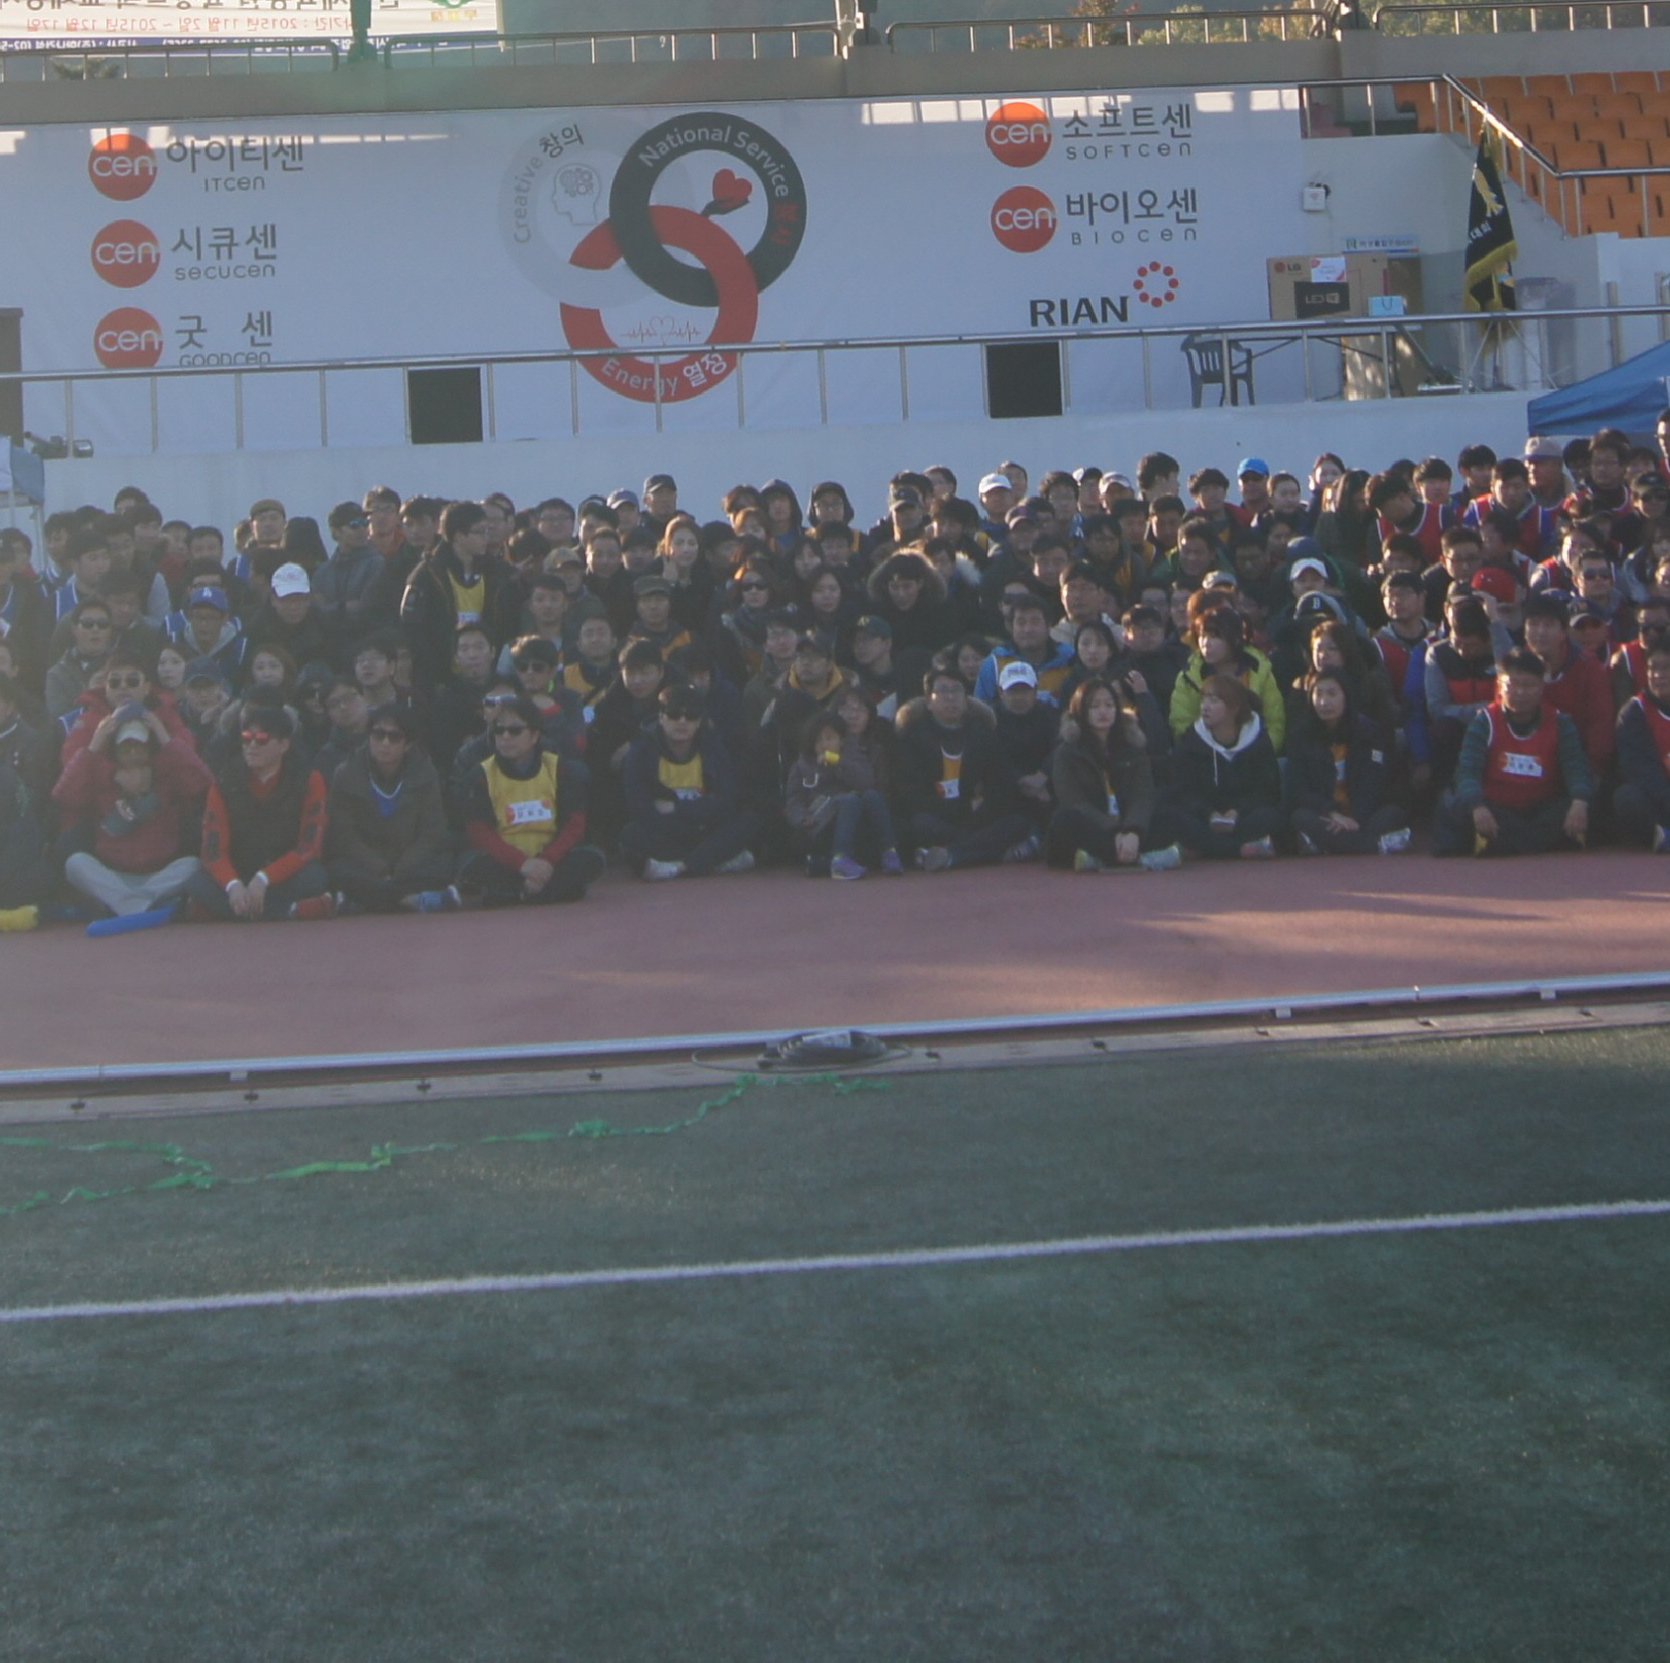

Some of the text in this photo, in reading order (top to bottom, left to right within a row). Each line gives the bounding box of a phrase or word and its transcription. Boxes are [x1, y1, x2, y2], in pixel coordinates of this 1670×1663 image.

[1062, 104, 1193, 139] 소프트센
[166, 135, 305, 174] 아이티센
[638, 124, 733, 169] National
[732, 130, 790, 199] Service
[513, 123, 585, 245] Creative 창의
[1066, 187, 1198, 225] 바이오센
[171, 222, 278, 262] 시큐센
[1029, 294, 1129, 327] RIAN
